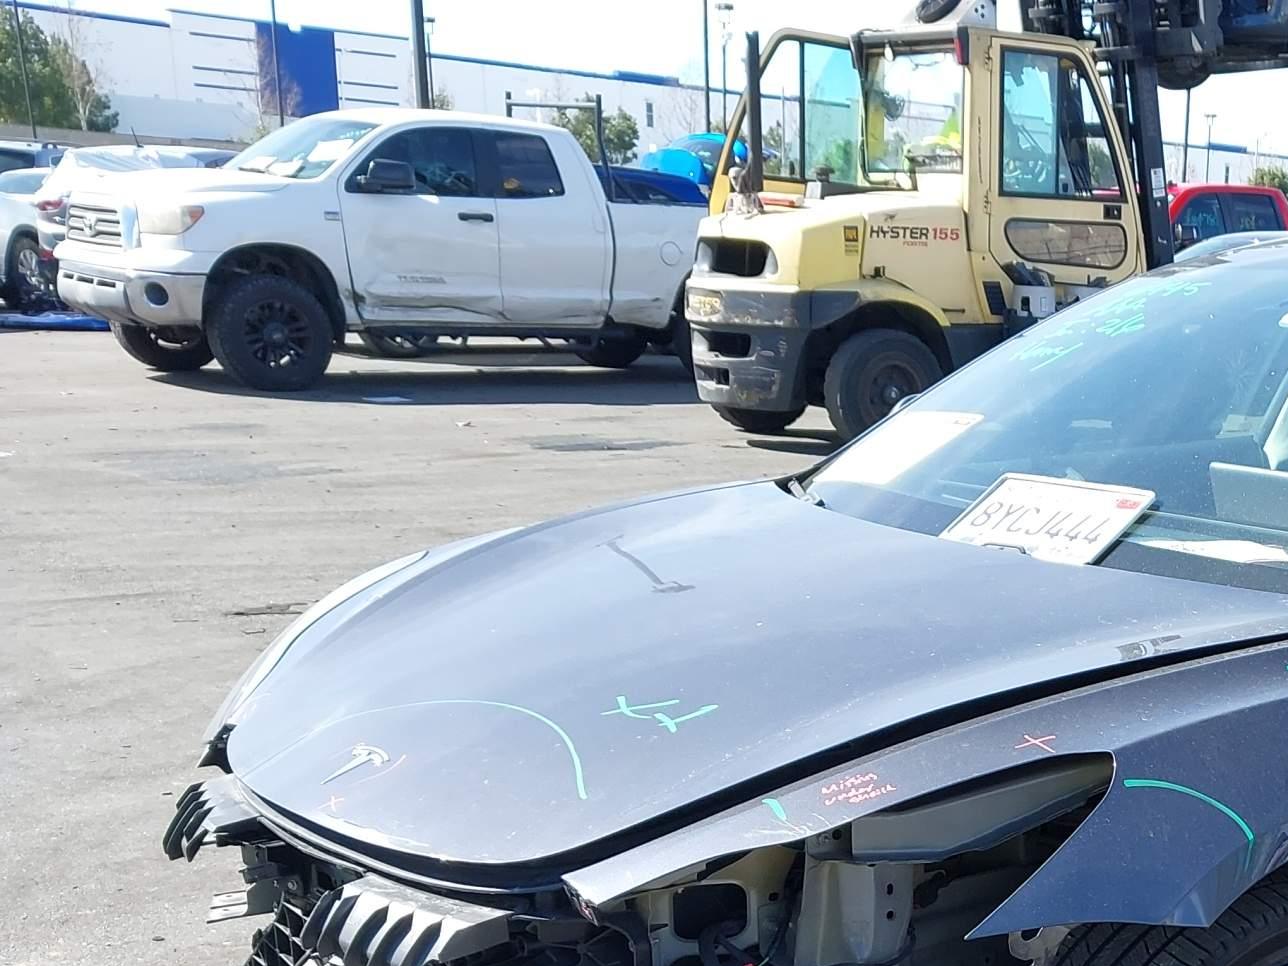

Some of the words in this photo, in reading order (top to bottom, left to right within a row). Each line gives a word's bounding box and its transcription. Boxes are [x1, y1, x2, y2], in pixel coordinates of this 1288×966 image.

[869, 225, 929, 241] HYSTER
[932, 227, 960, 241] 155
[970, 500, 1110, 545] 8YCJ444
